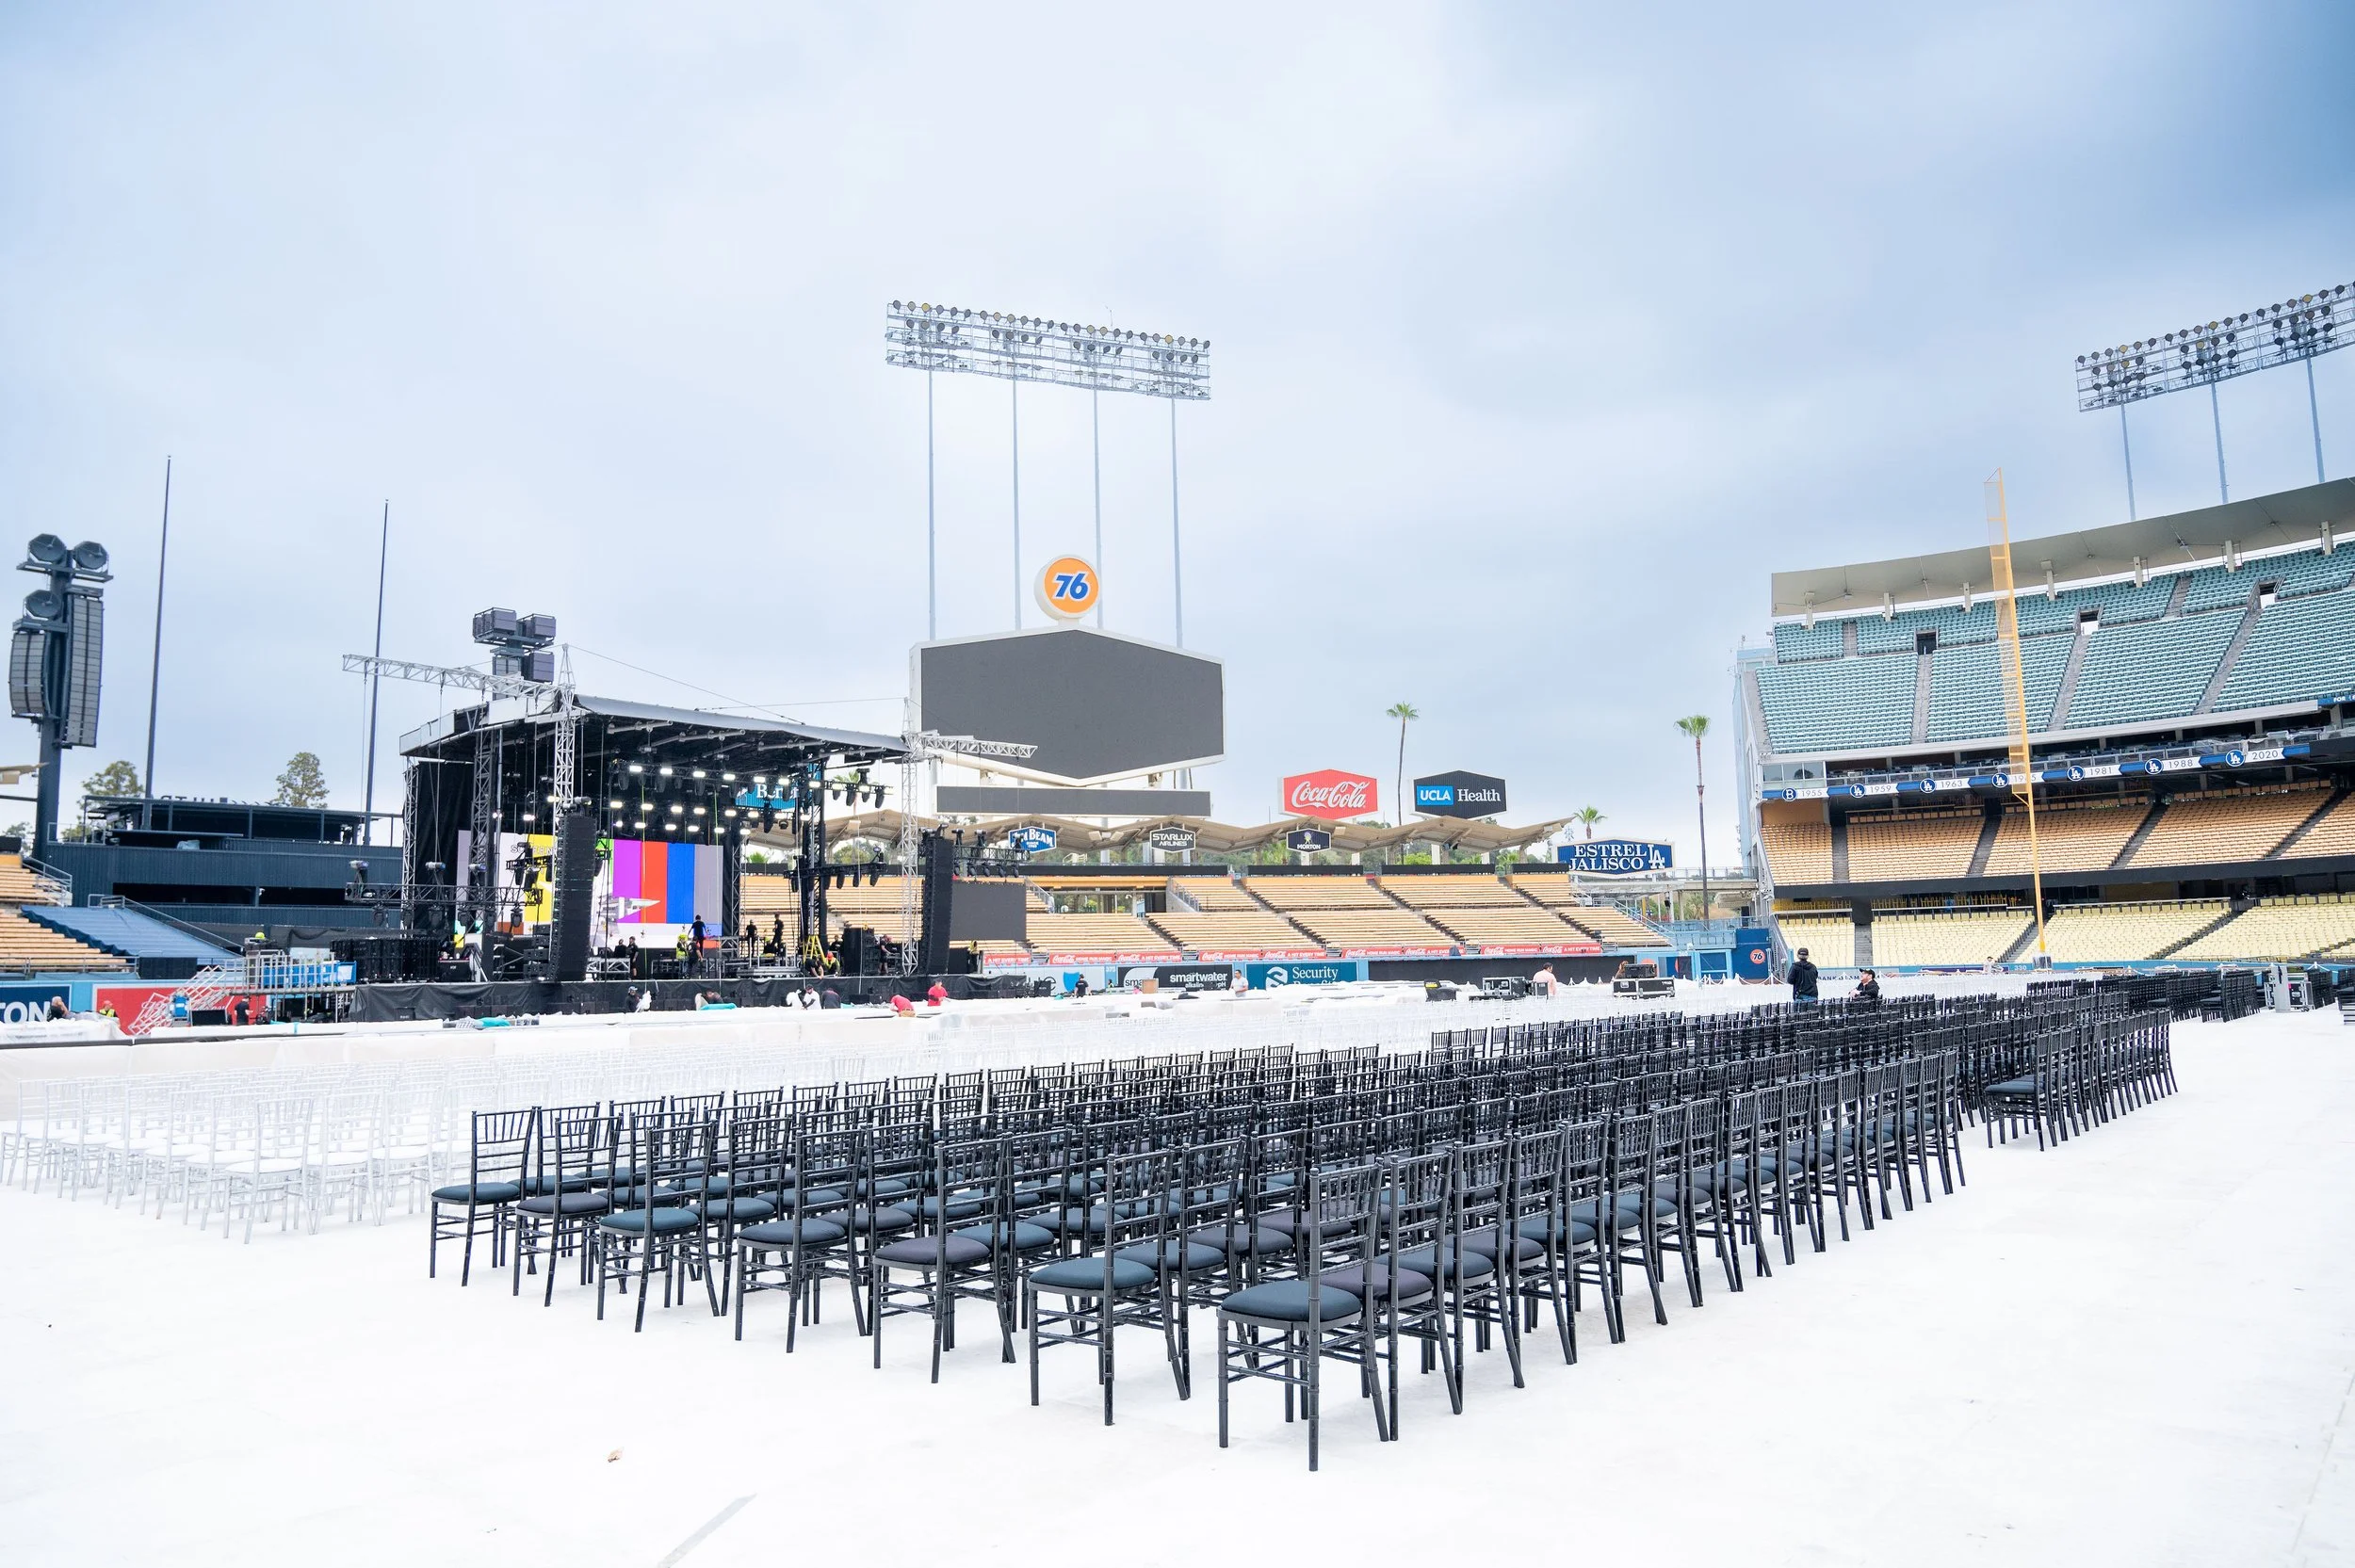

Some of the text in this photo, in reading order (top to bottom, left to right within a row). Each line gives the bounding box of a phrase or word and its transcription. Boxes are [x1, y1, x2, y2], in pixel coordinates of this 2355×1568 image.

[1054, 571, 1090, 601] 76
[2252, 751, 2279, 760] 2020
[2168, 760, 2193, 768] 1988
[1941, 780, 1963, 788] 1963
[1291, 781, 1370, 808] Coca-Cola
[1420, 788, 1501, 802] UCLA Health
[1029, 829, 1054, 848] BEAM
[1574, 844, 1647, 858] ESTREL
[1568, 857, 1644, 871] JALISCO
[1170, 972, 1228, 983] smartwater
[1292, 966, 1339, 980] Security
